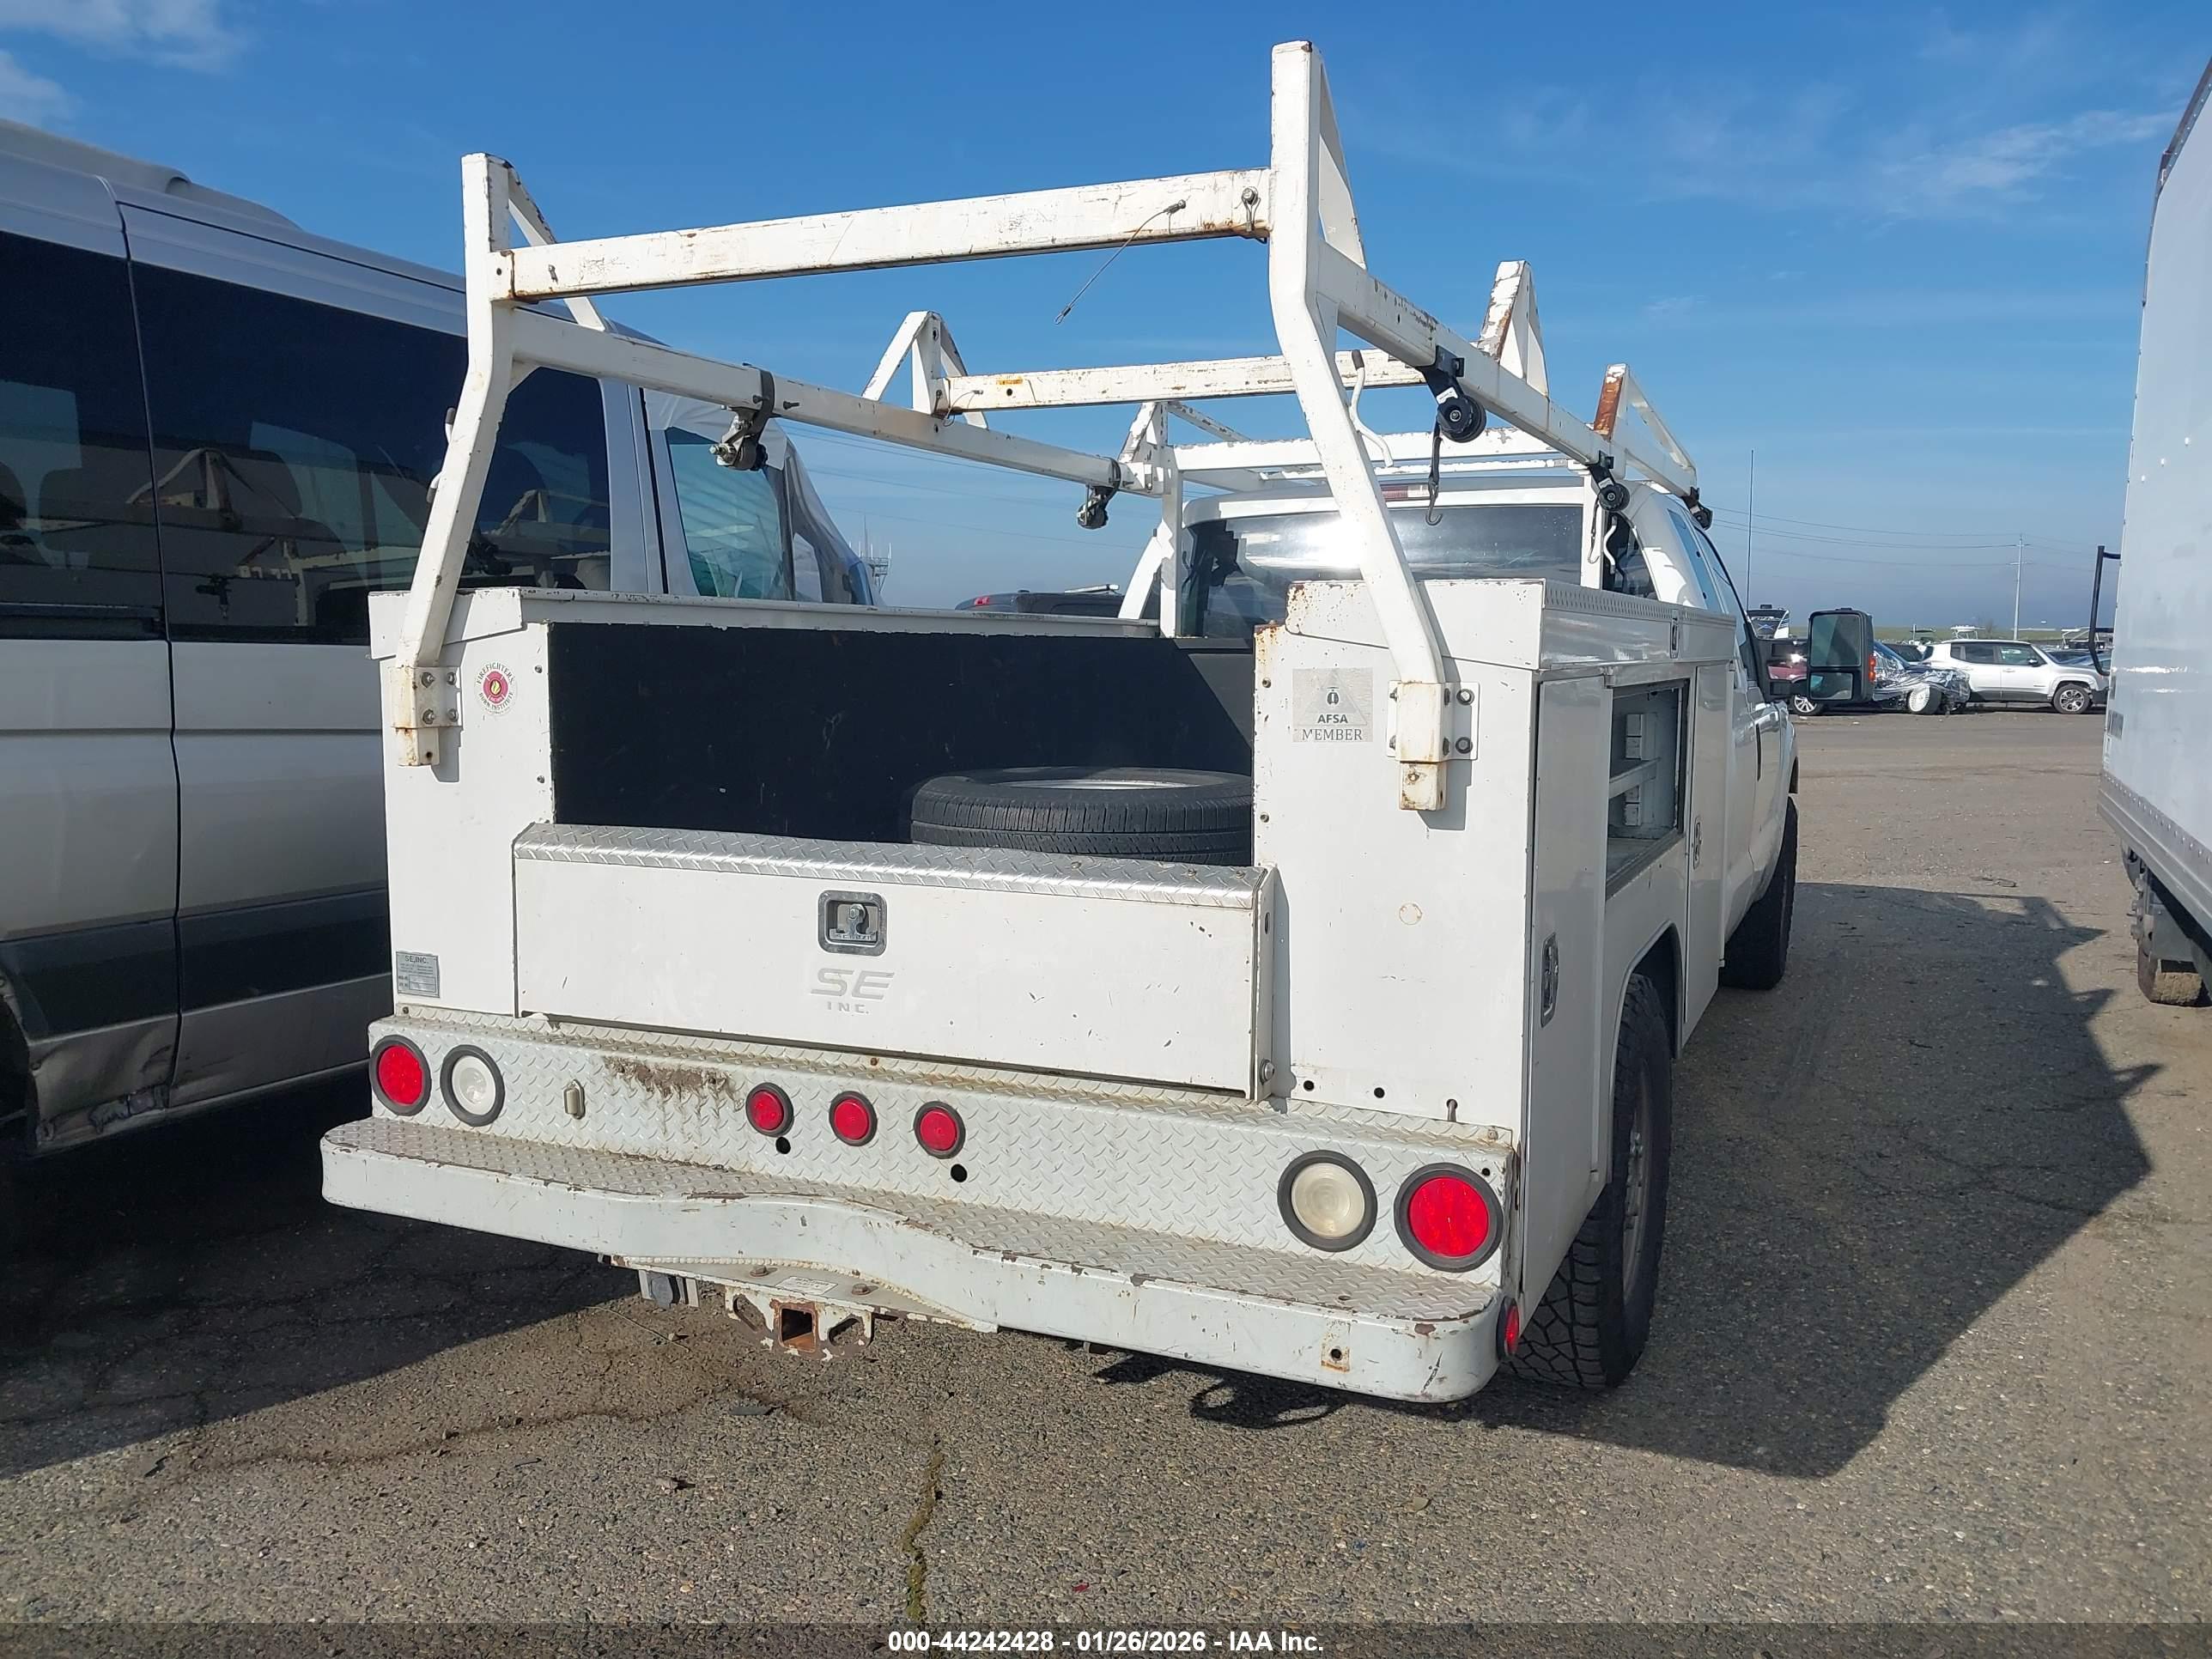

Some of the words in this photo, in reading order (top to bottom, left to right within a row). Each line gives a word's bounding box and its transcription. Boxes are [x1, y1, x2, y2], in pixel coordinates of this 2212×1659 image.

[1317, 714, 1348, 724] AFSA
[1302, 728, 1363, 741] MEMBER
[811, 967, 895, 1000] SE
[827, 1001, 869, 1014] INC.
